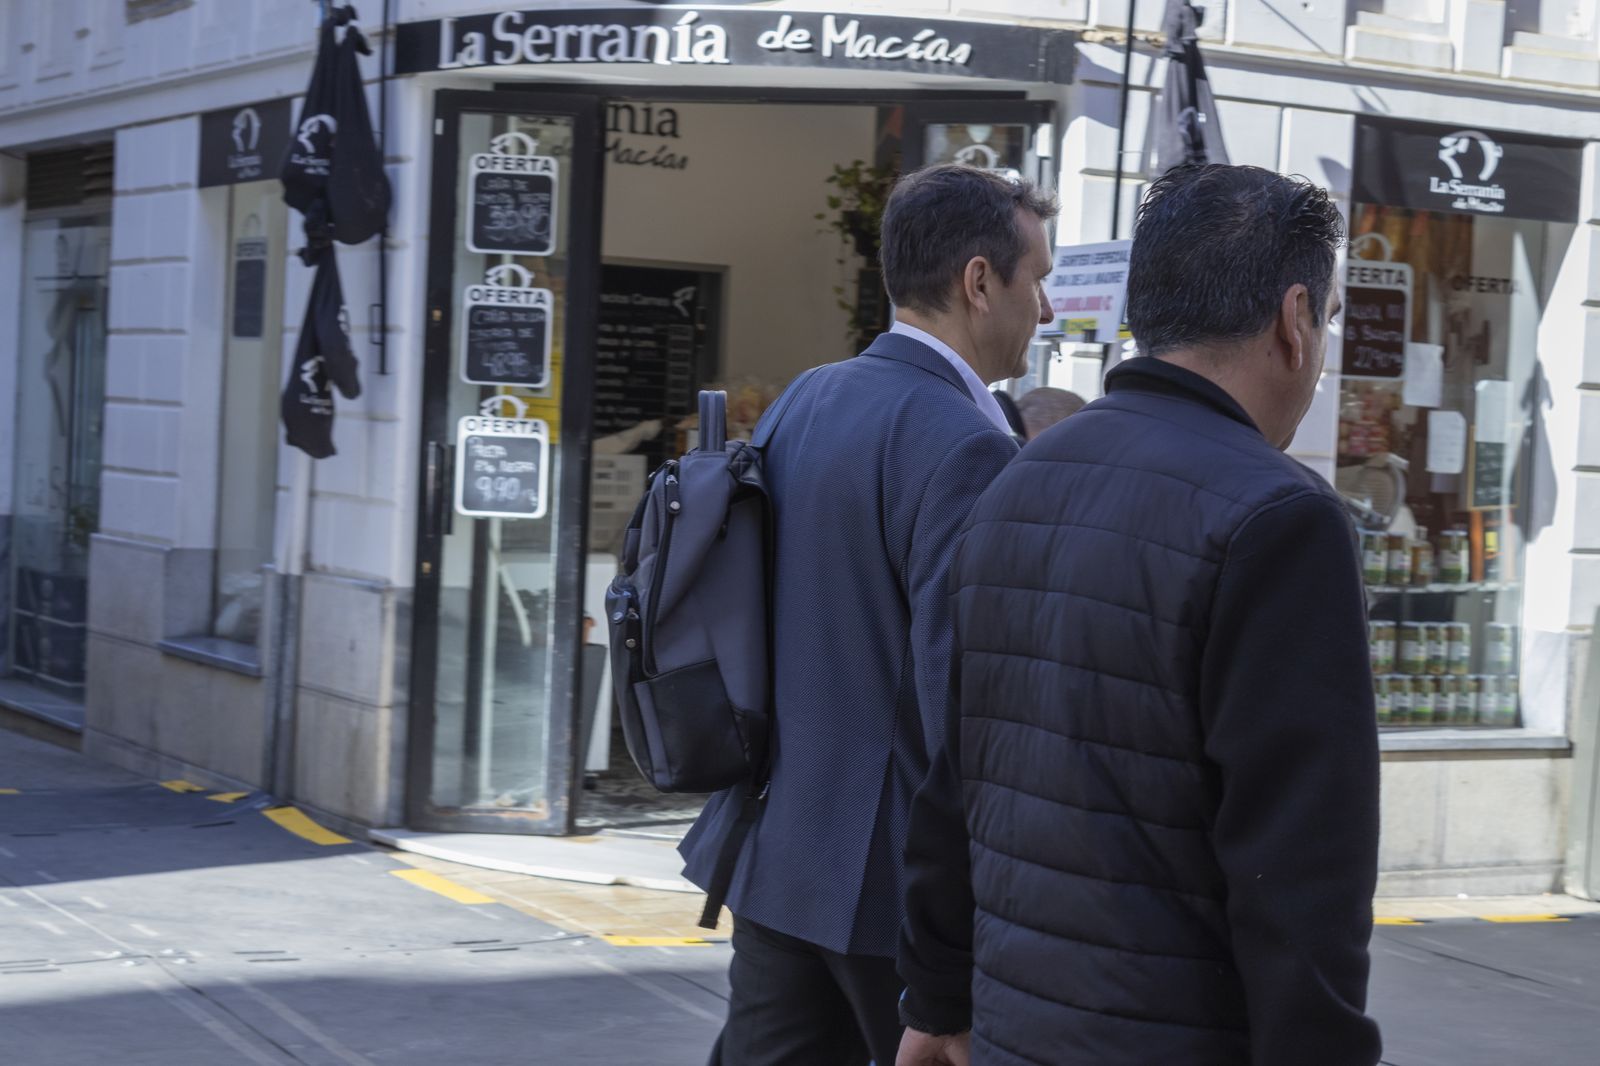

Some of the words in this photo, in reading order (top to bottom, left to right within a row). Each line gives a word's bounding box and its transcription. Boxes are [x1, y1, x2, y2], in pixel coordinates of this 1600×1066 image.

[438, 18, 487, 68] La
[491, 11, 731, 66] Serranía
[757, 14, 813, 49] de
[821, 14, 972, 65] Macías
[475, 156, 552, 171] OFERTA
[1347, 266, 1408, 287] FERTA
[470, 288, 546, 305] OFERTA
[466, 418, 541, 435] OFERTA
